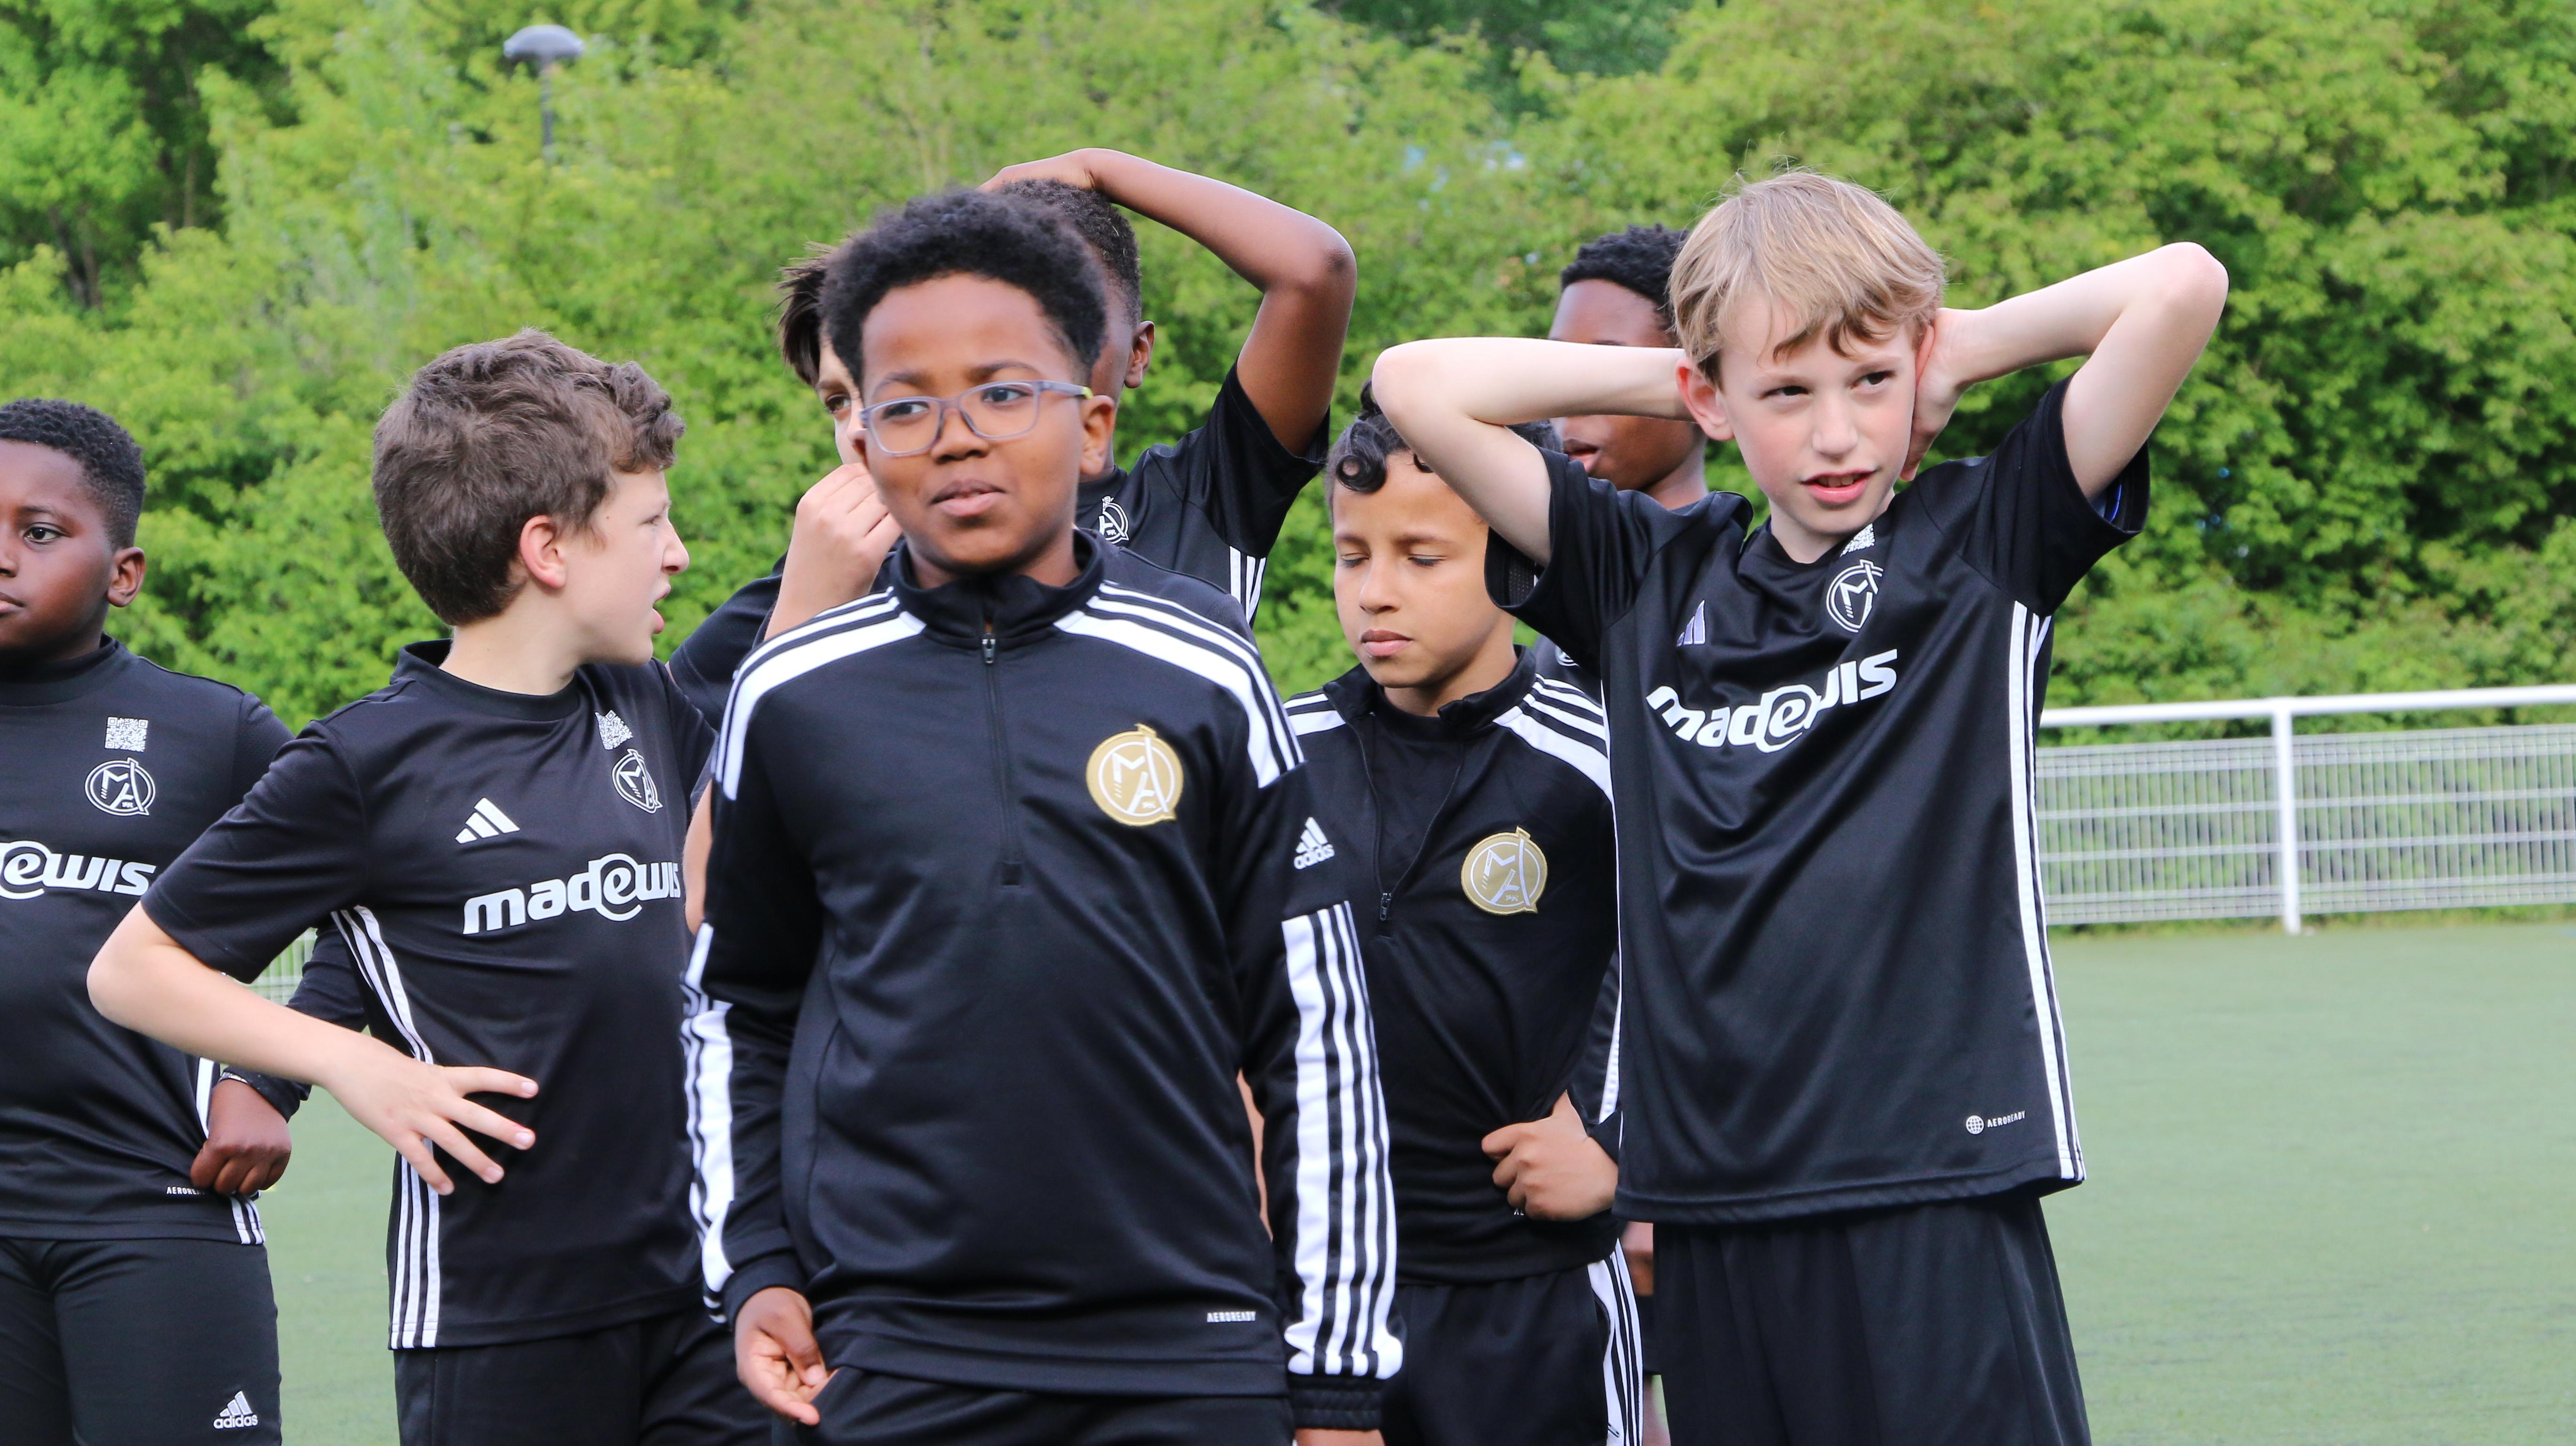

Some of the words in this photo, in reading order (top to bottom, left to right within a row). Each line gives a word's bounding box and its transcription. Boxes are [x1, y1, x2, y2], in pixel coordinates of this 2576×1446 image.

[1987, 1110, 2026, 1128] AEROREADY
[1207, 1311, 1256, 1323] AEROREADY
[213, 1413, 258, 1429] adidas
